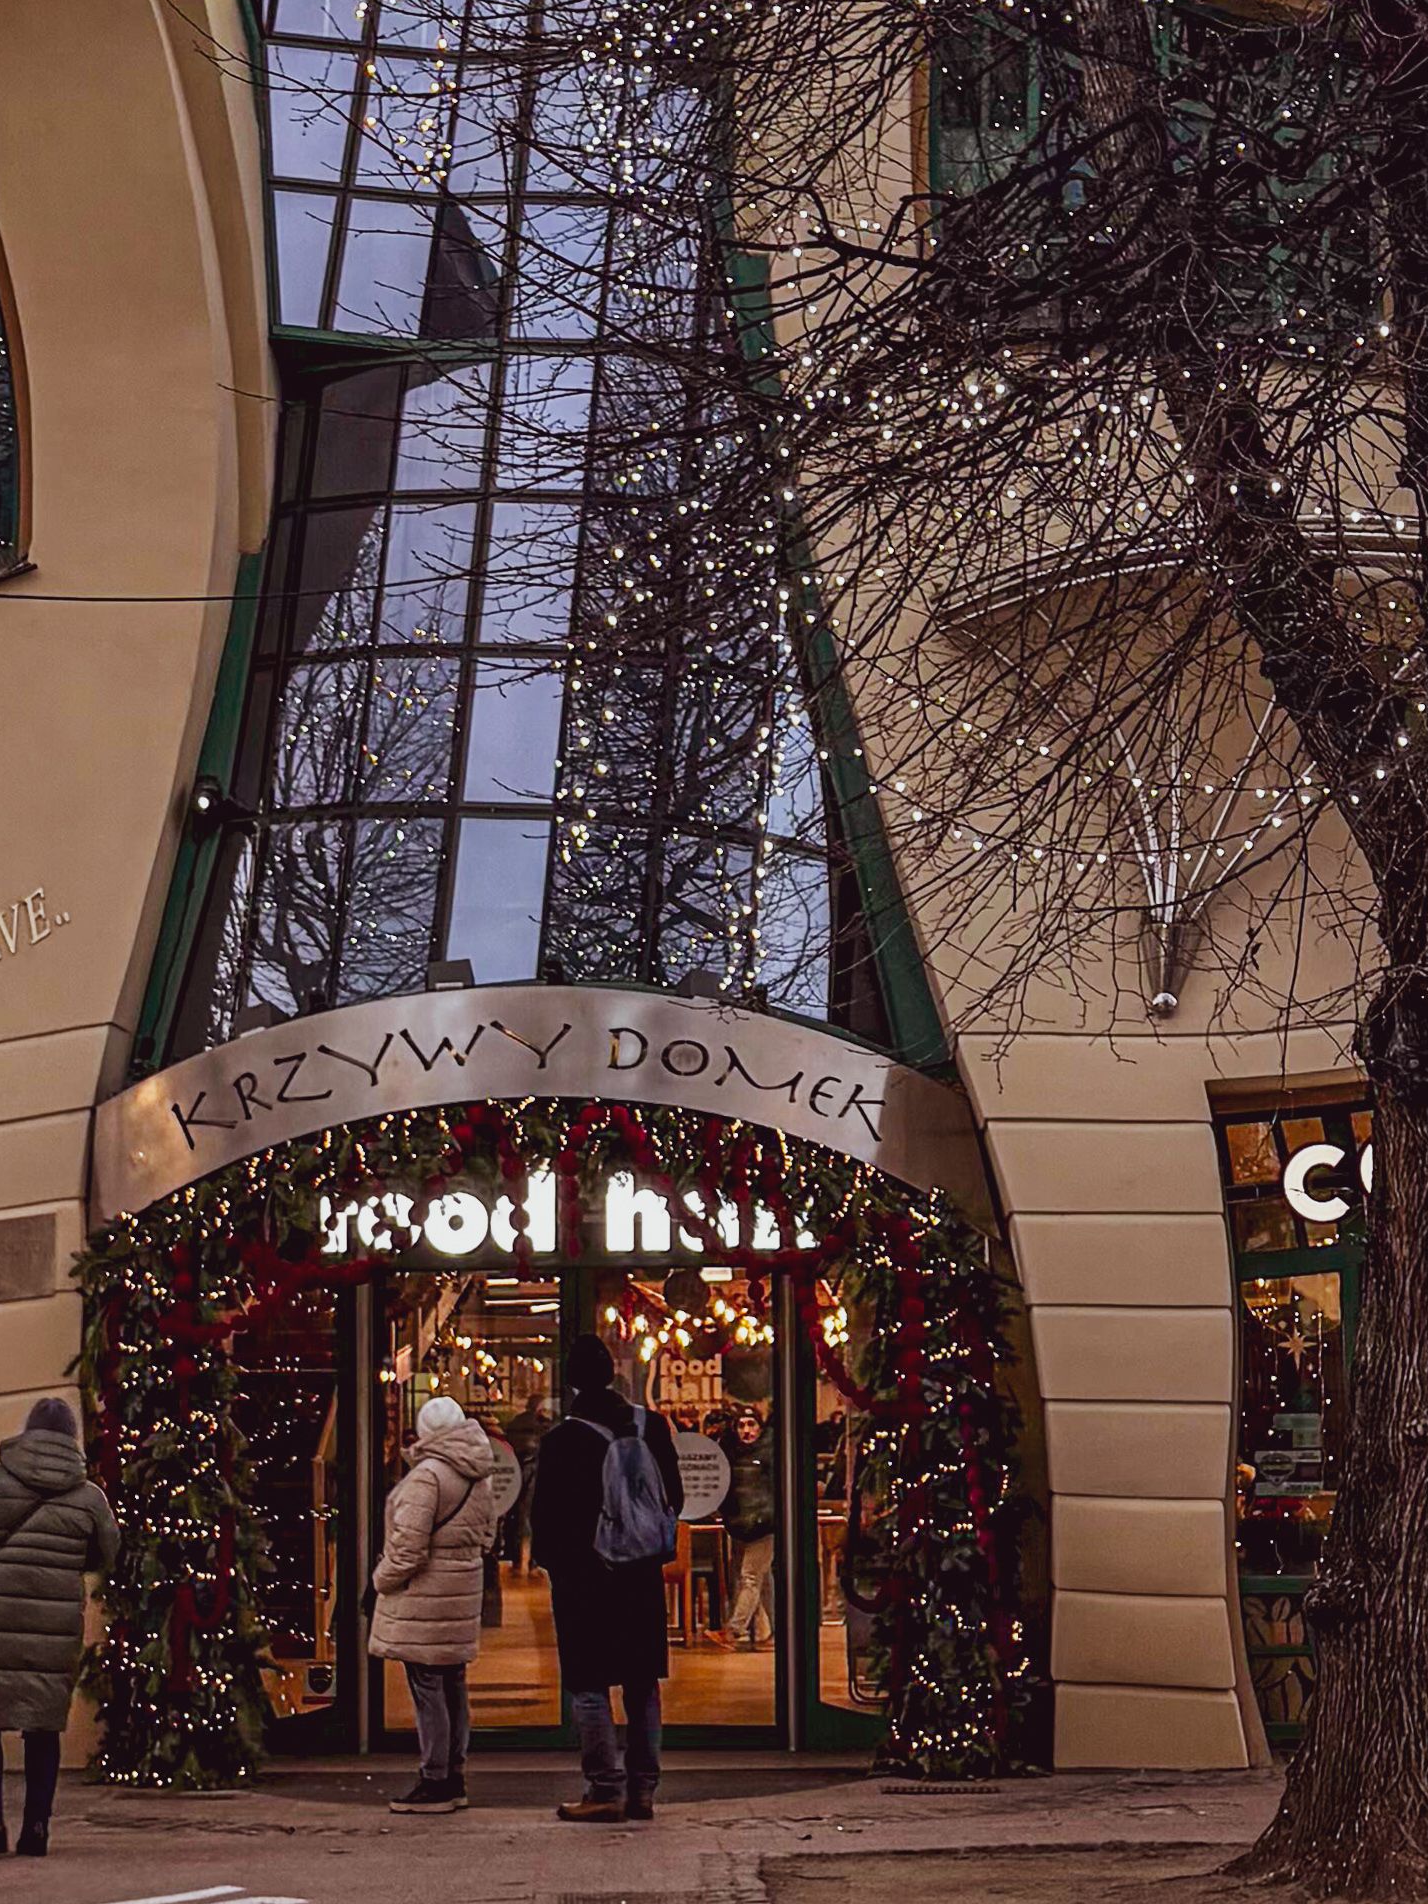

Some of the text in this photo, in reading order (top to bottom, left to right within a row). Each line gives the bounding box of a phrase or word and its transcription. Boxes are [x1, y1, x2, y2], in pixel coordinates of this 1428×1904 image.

[170, 1019, 887, 1151] KRZYWY DOMEK
[660, 1352, 723, 1375] food
[660, 1376, 723, 1401] hall
